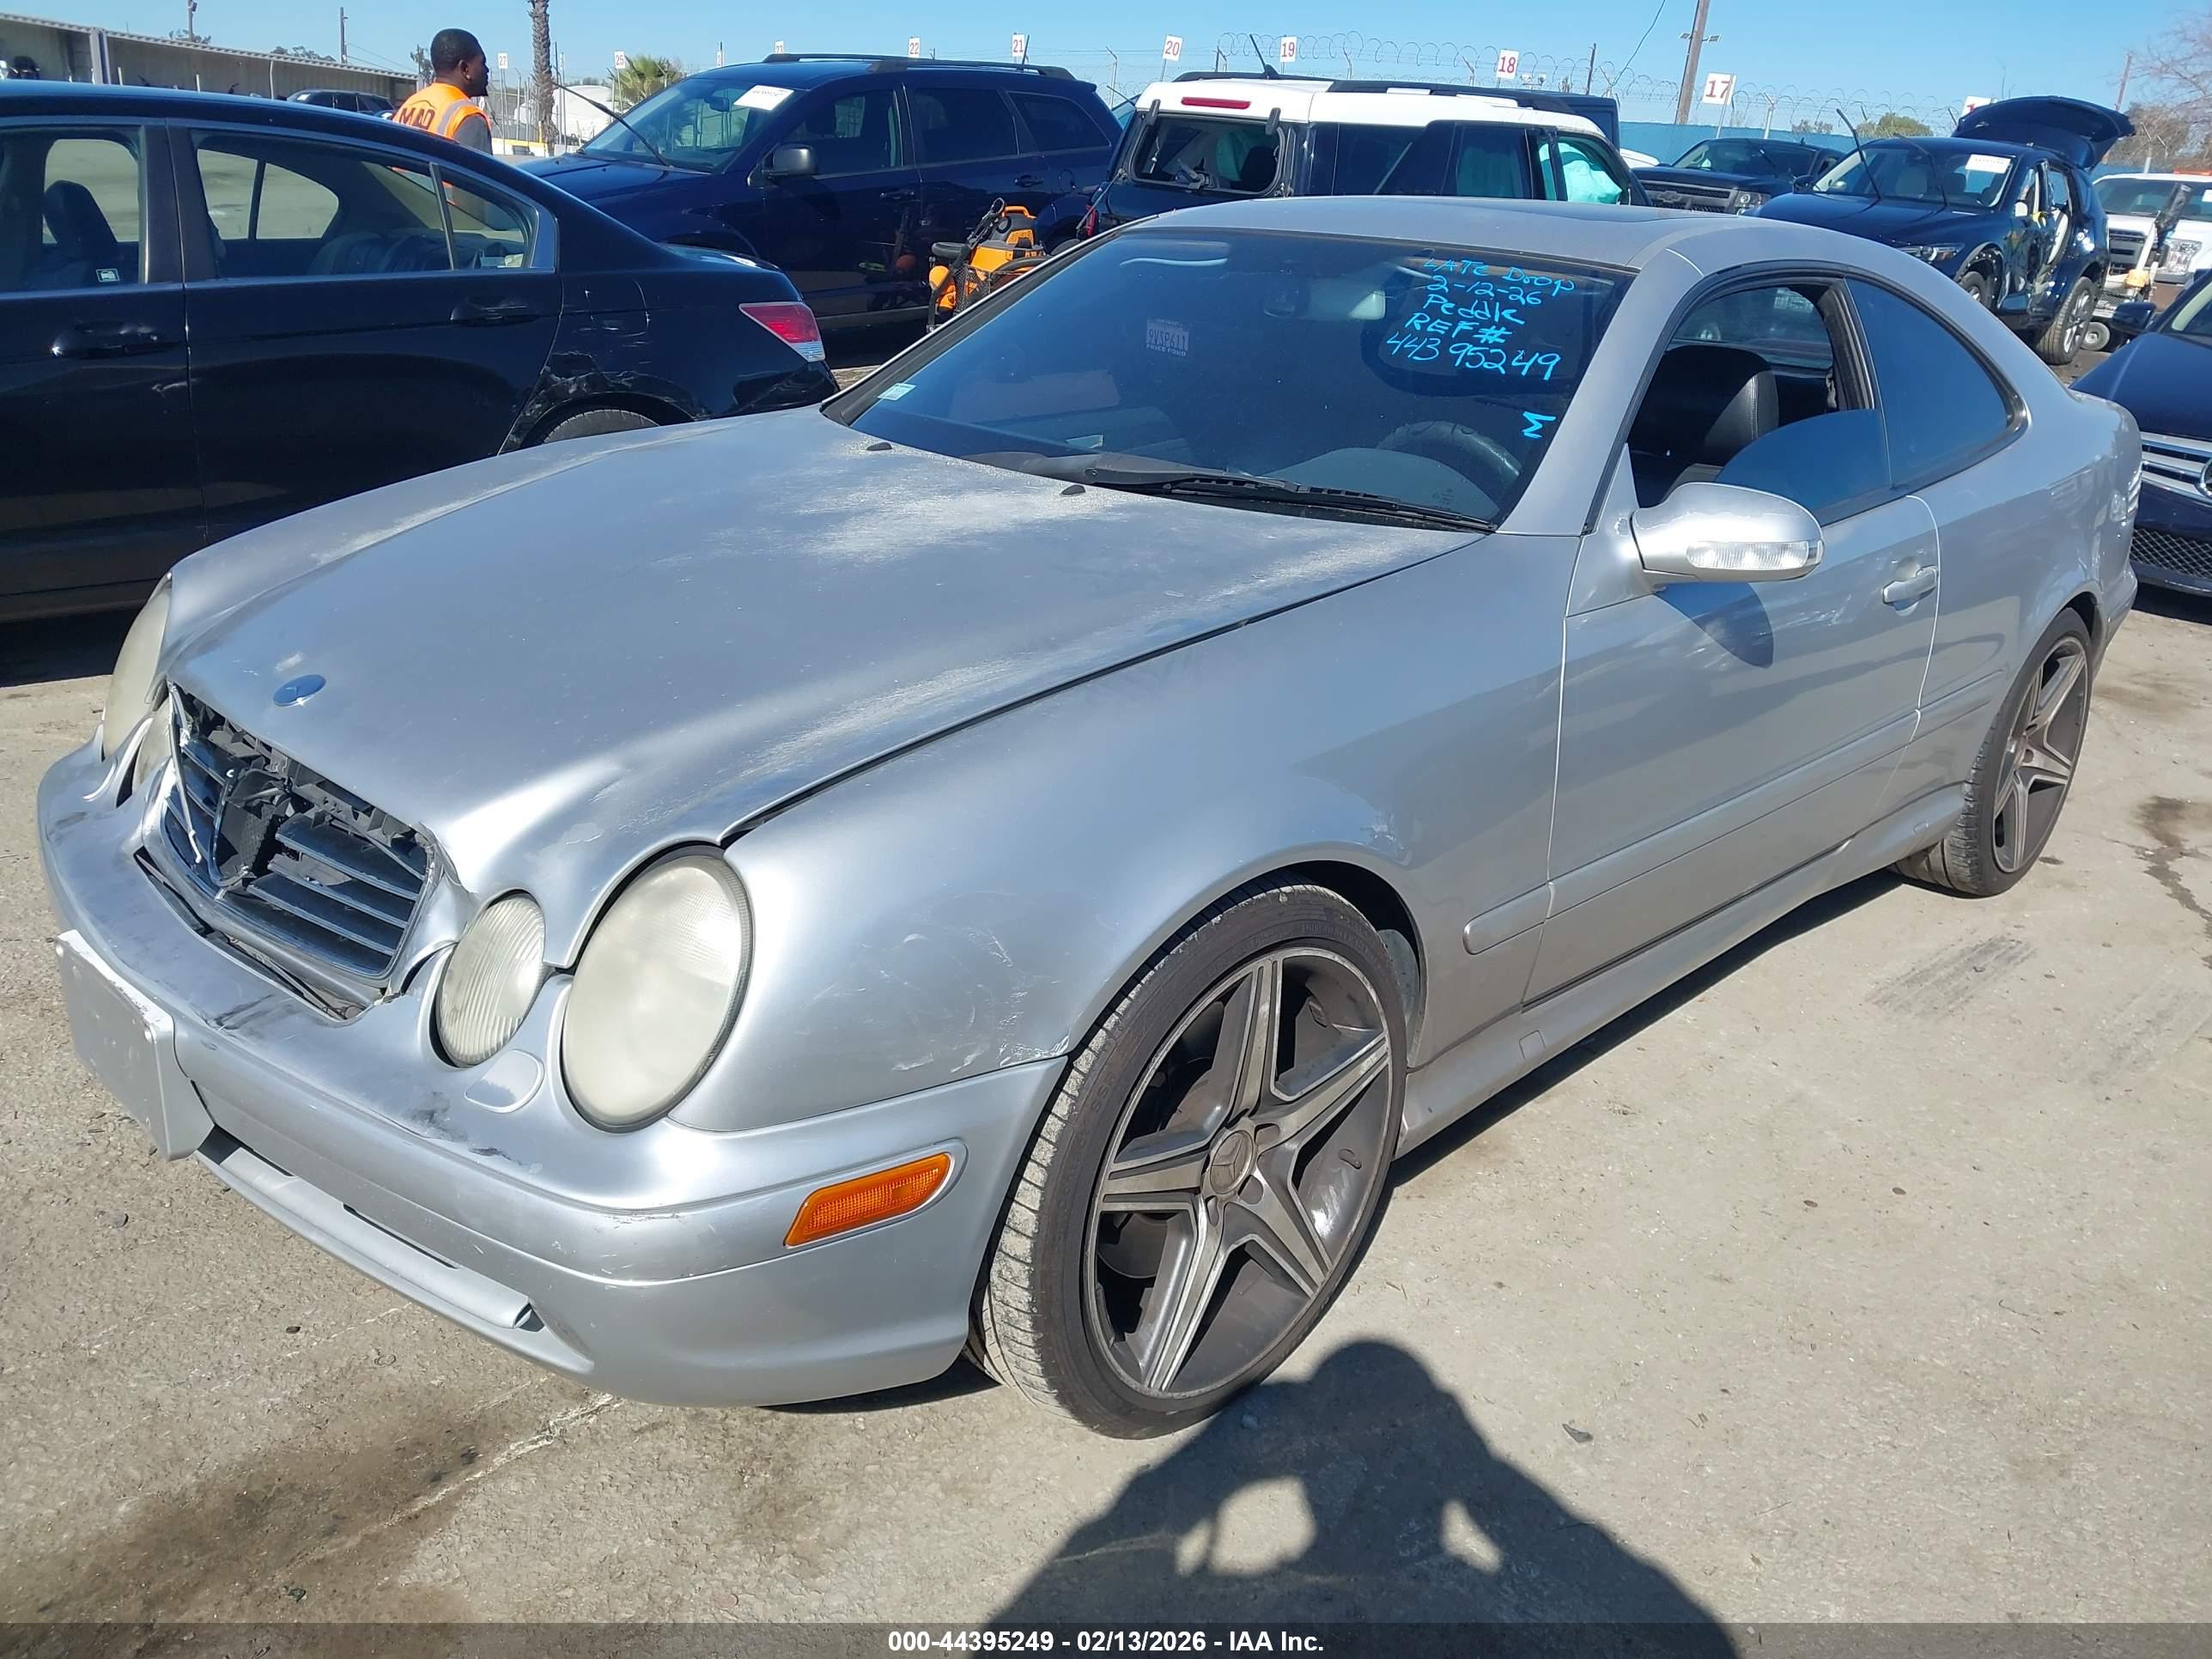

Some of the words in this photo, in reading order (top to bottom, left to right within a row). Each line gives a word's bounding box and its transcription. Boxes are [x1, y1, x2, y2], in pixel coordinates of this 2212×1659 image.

[909, 42, 919, 54] 22
[1013, 40, 1024, 53] 21
[1165, 40, 1180, 56] 20
[1281, 41, 1295, 58] 19
[499, 56, 507, 66] 27
[616, 55, 624, 66] 25
[1498, 56, 1516, 74] 18
[1705, 80, 1732, 99] 17
[1426, 276, 1543, 306] 2-12-26
